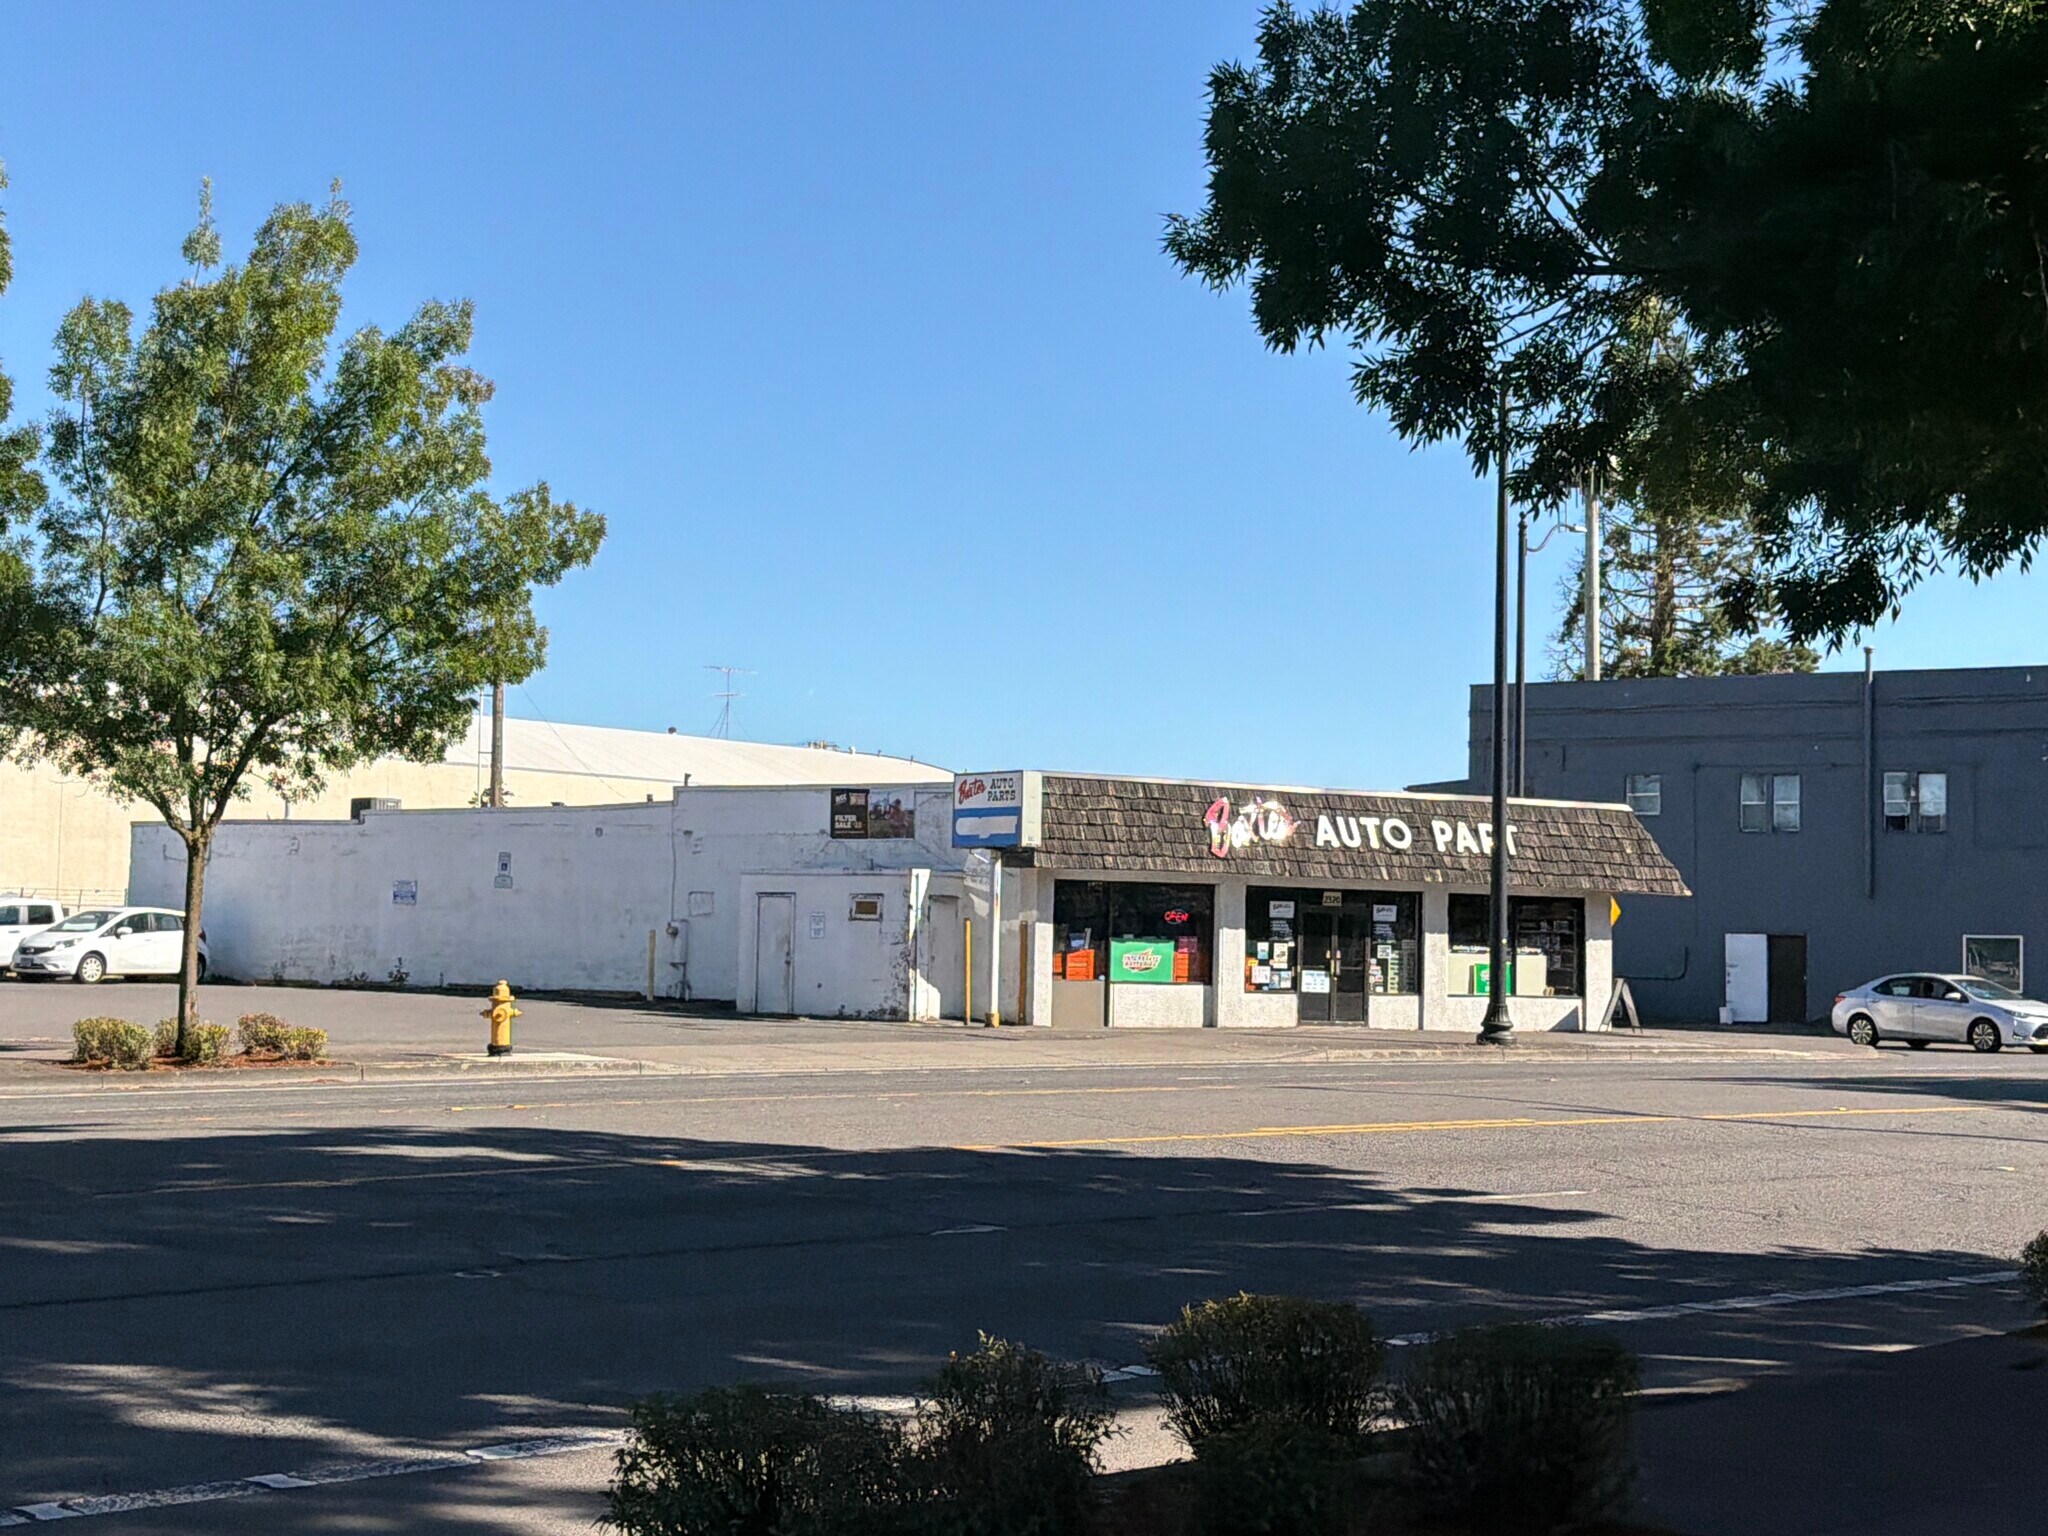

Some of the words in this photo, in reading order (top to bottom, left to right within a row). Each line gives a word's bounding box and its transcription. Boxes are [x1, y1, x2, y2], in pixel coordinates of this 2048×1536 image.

[990, 777, 1014, 790] AUTO
[987, 789, 1016, 802] PARTS
[834, 814, 857, 822] FILTER
[834, 821, 852, 829] SALE
[1315, 814, 1413, 851] AUTO
[1164, 910, 1189, 923] OPEN
